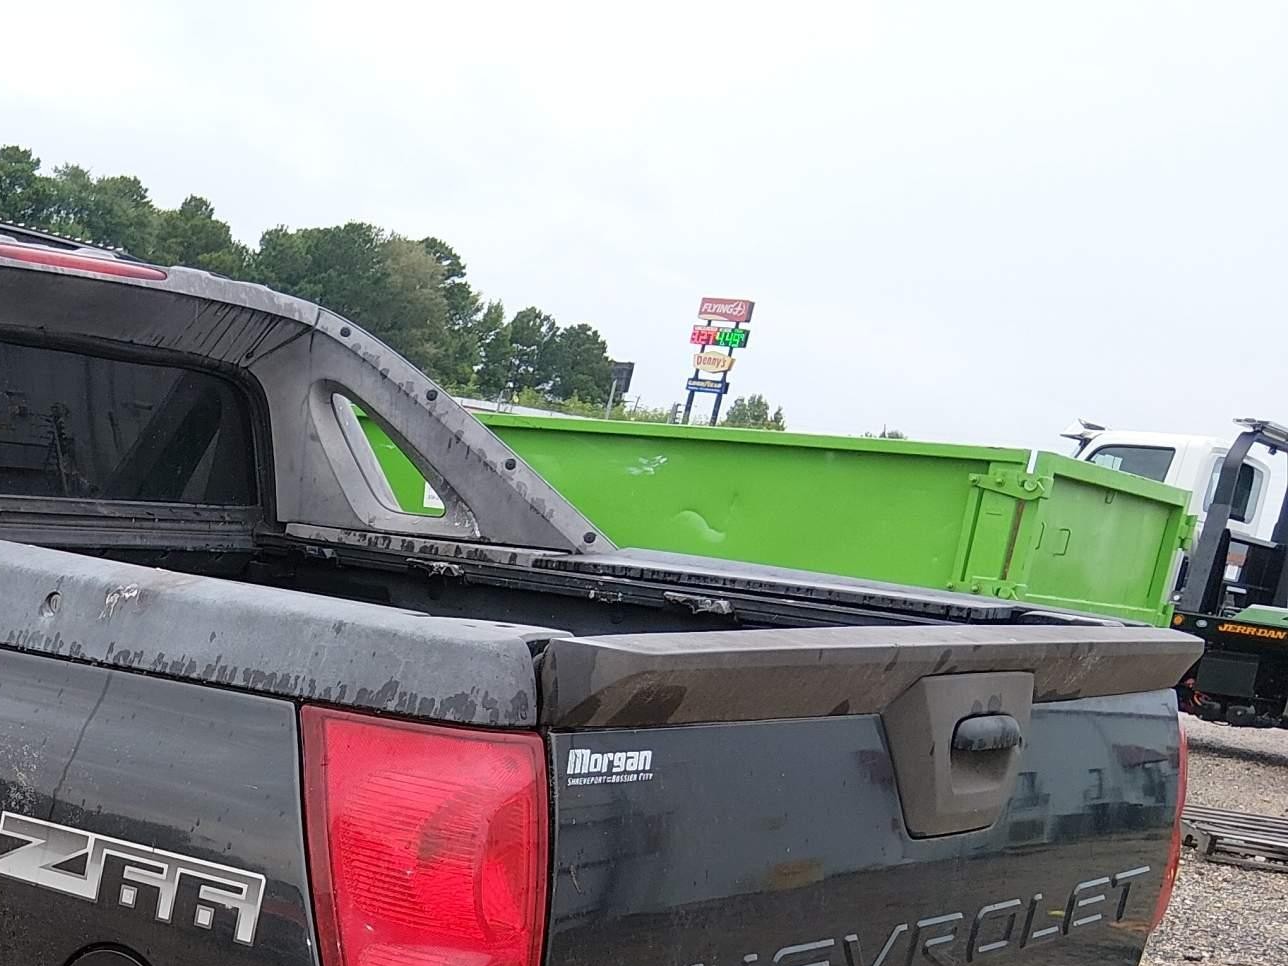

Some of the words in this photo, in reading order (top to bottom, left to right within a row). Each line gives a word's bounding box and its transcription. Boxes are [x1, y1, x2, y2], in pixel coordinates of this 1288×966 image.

[702, 303, 733, 314] FLYING
[697, 355, 727, 368] Denny's
[567, 748, 652, 774] Morgan
[638, 772, 653, 781] CITY
